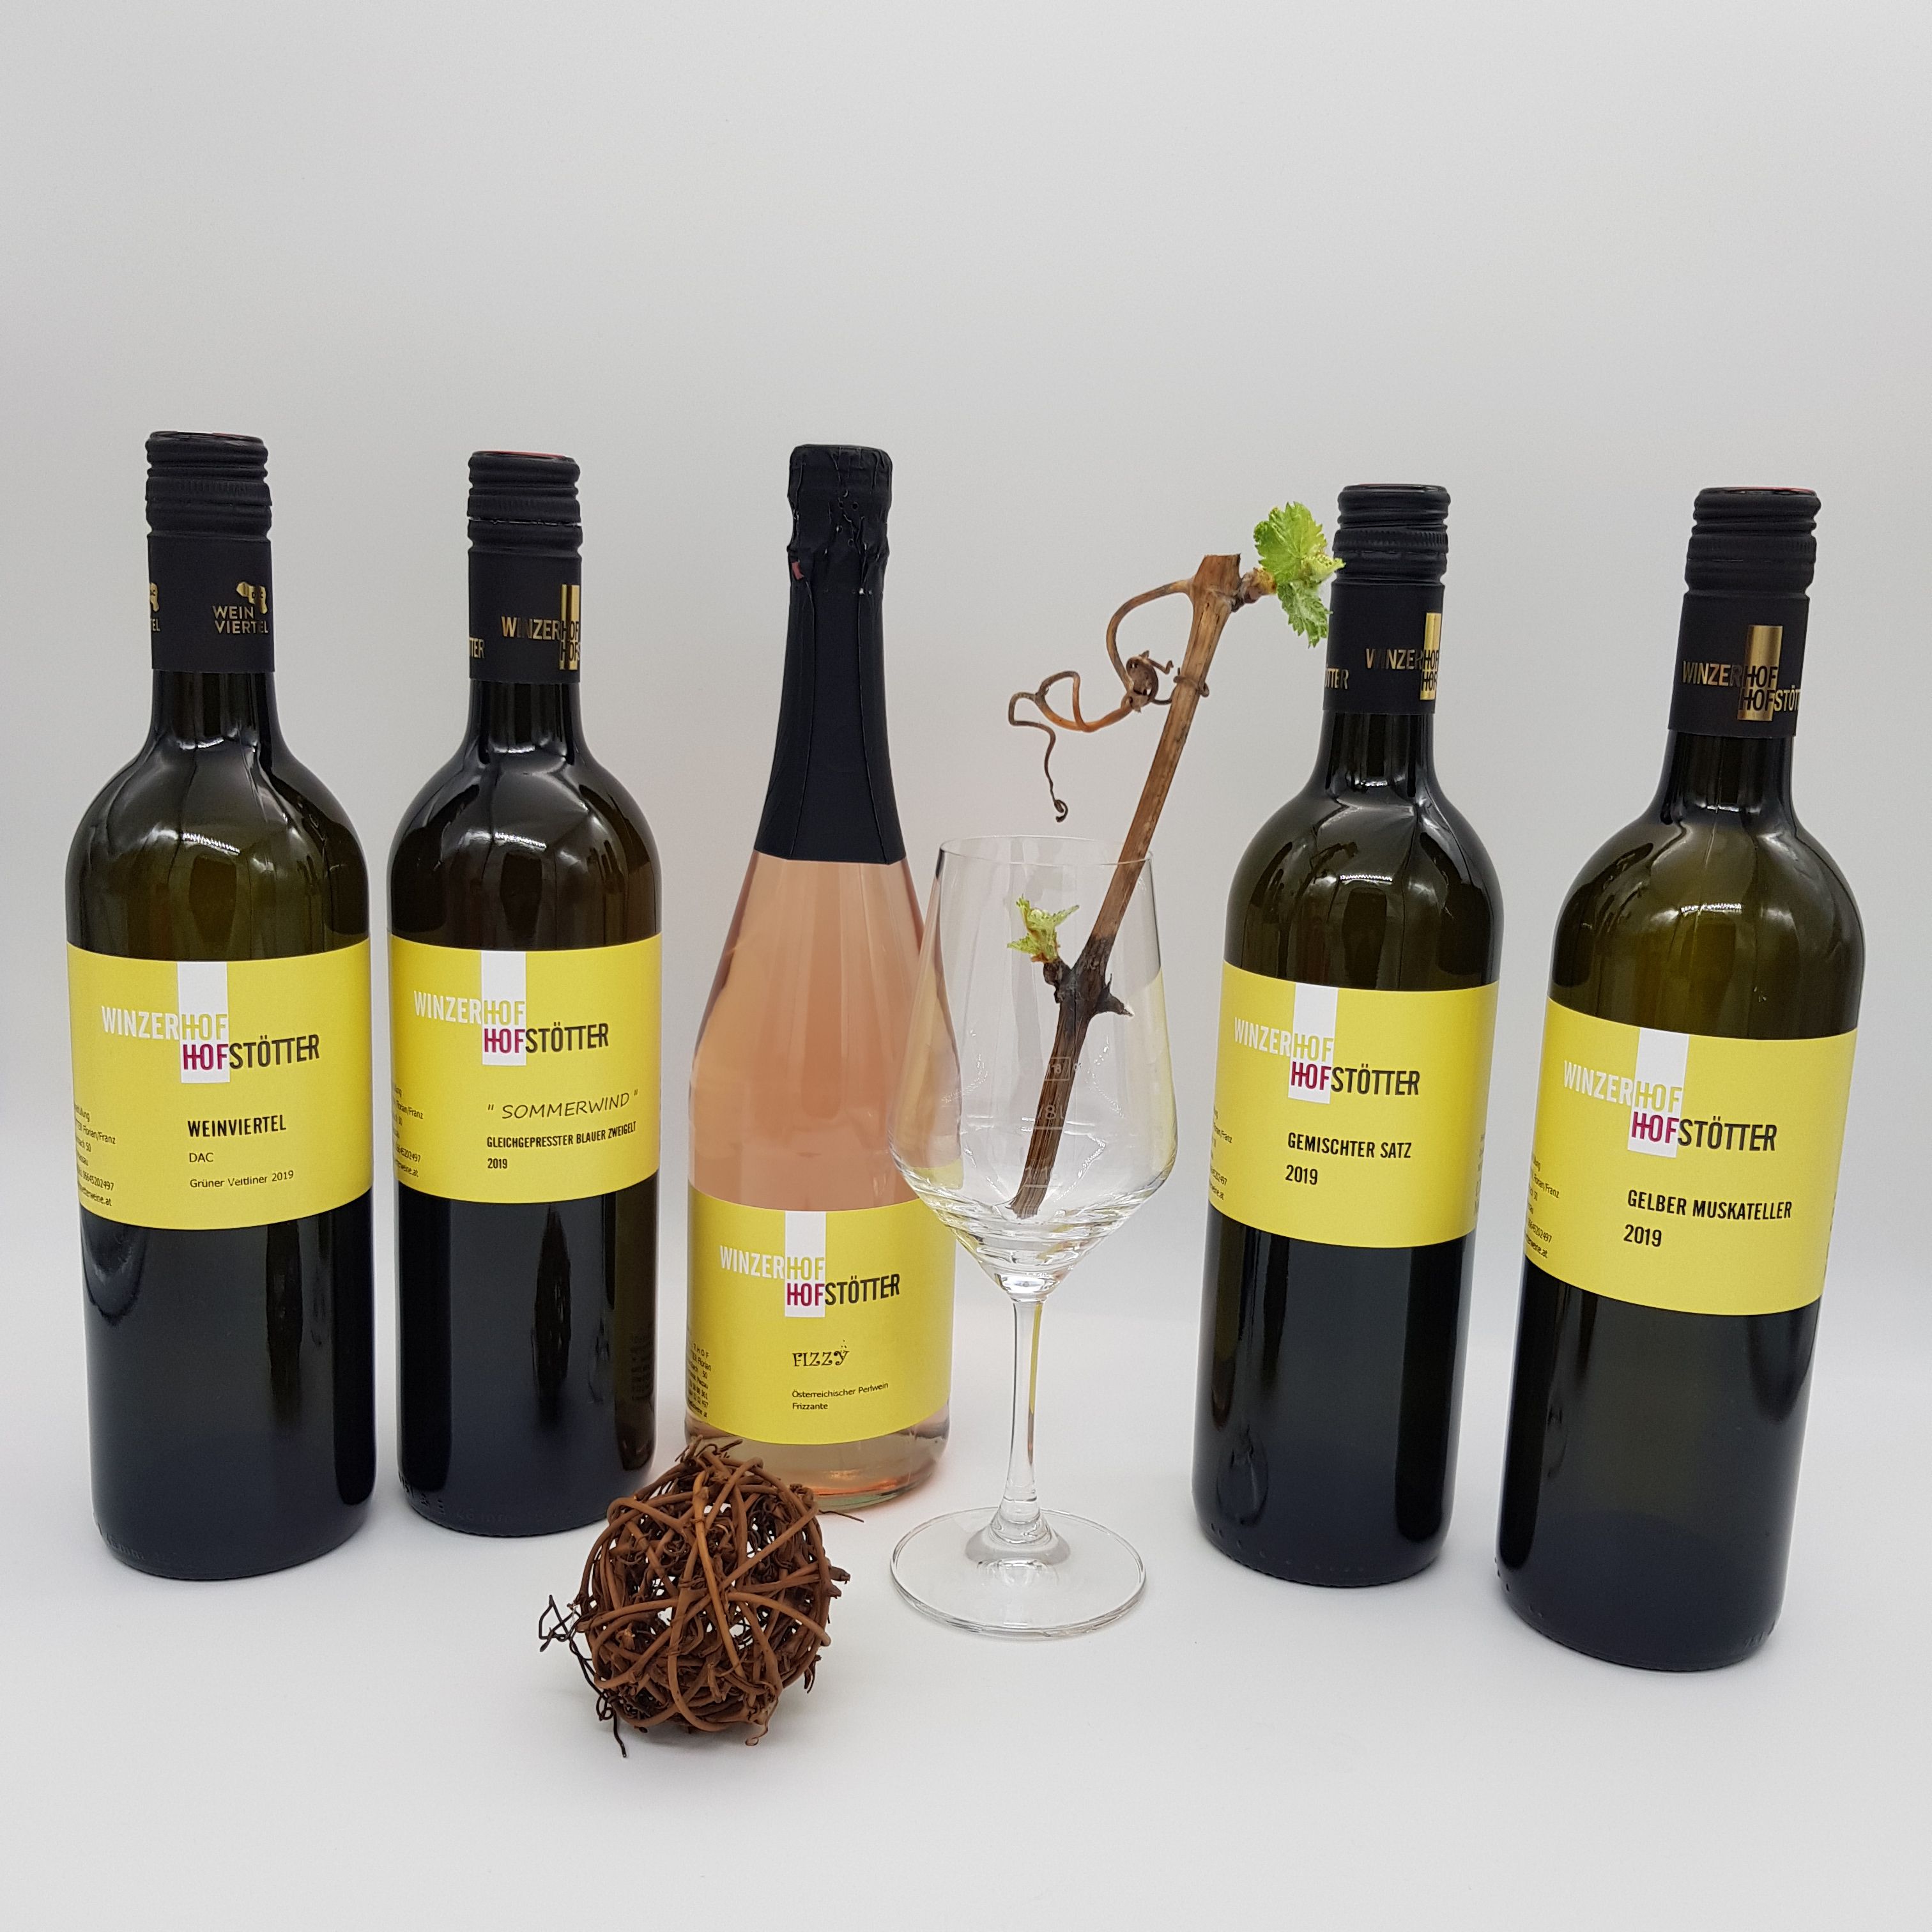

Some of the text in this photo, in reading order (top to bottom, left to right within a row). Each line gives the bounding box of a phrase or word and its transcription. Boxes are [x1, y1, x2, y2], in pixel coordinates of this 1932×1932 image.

[213, 606, 254, 619] WEIN
[215, 620, 269, 634] VIERTEL
[1682, 661, 1778, 688] WINZERHOF
[413, 990, 525, 1025] WINZERHOF
[102, 1006, 228, 1041] WINZERHOF
[484, 1022, 609, 1054] HOFSTÖTTER
[1234, 1017, 1333, 1062] WINZERHOF
[183, 1034, 320, 1071] HOFSTÖTTER
[1291, 1061, 1420, 1096] HOFSTÖTTER
[1563, 1060, 1683, 1112] WINZERHOF
[502, 1092, 629, 1119] SOMMERWIND
[188, 1114, 287, 1137] WEINVIERTEL
[487, 1121, 636, 1148] GLEICHGEPRESSTER BLAUER ZWEIGELT
[1631, 1111, 1777, 1151] HOFSTÖTTER
[189, 1152, 214, 1163] DAC
[1287, 1131, 1412, 1158] GEMISCHTER SATZ
[487, 1158, 508, 1169] 2019
[1285, 1164, 1319, 1186] 2019
[190, 1170, 294, 1188] Grüner Veltliner 2019
[1627, 1189, 1792, 1221] GELBER MUSKATELLER
[1623, 1223, 1662, 1247] 2019
[719, 1245, 825, 1280] WINZERHOF
[786, 1273, 901, 1307] HOFSTÖTTER
[792, 1383, 889, 1398] Österreichischer Perlwein
